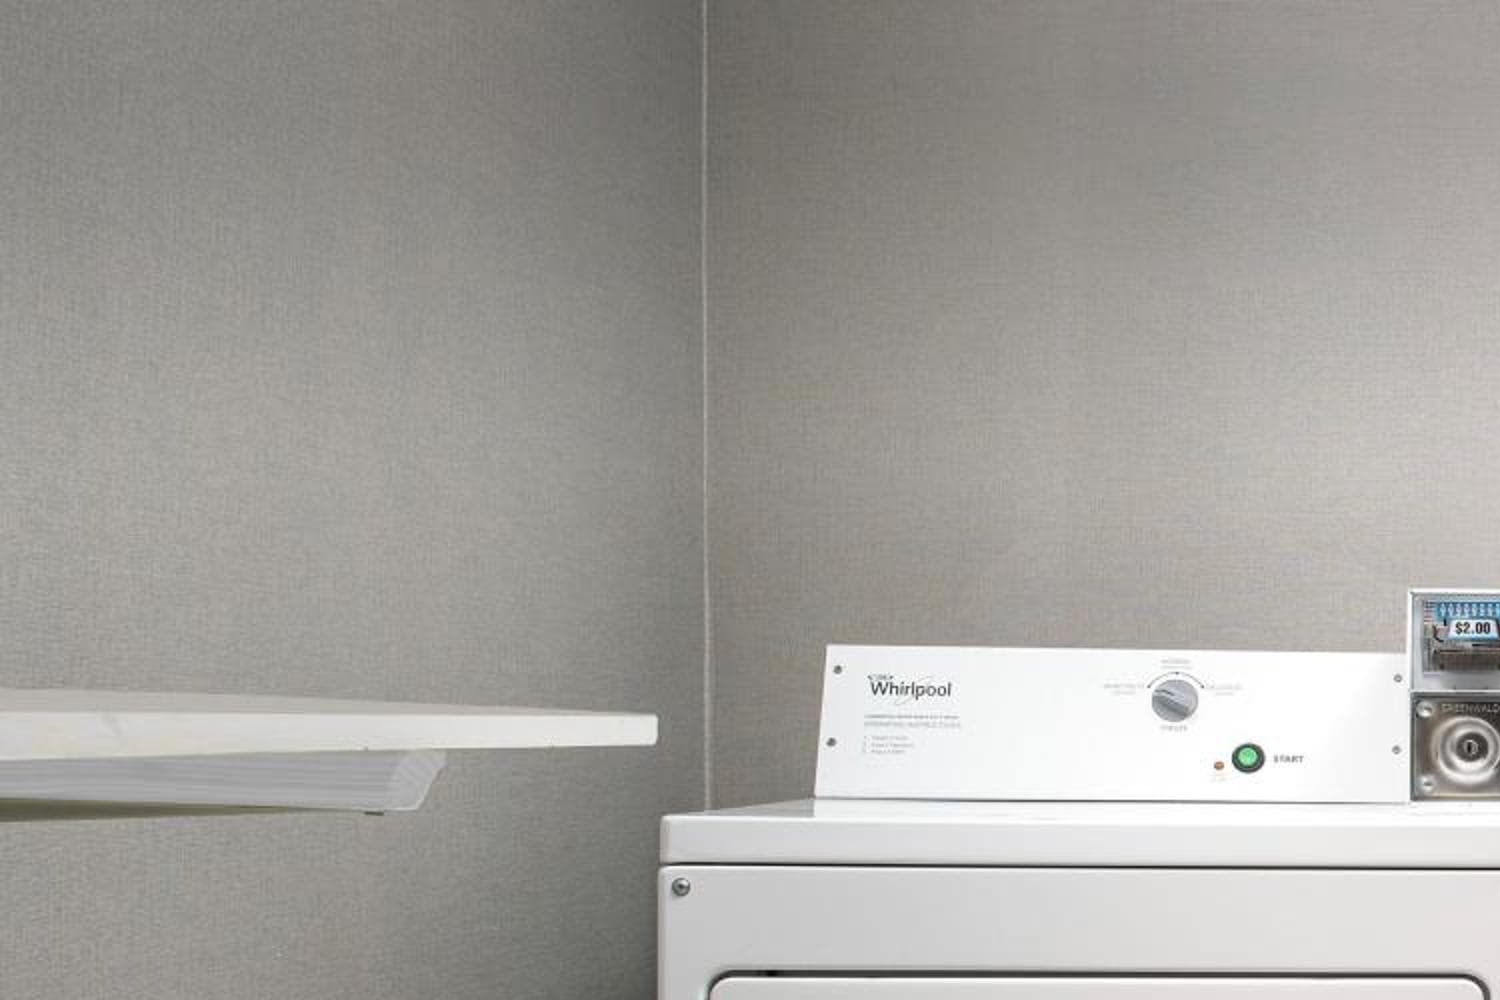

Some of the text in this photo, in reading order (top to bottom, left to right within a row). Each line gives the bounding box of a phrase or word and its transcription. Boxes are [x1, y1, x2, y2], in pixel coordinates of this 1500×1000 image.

[1454, 622, 1491, 635] $2.00
[870, 681, 952, 700] Whirlpool
[1273, 754, 1304, 763] START
